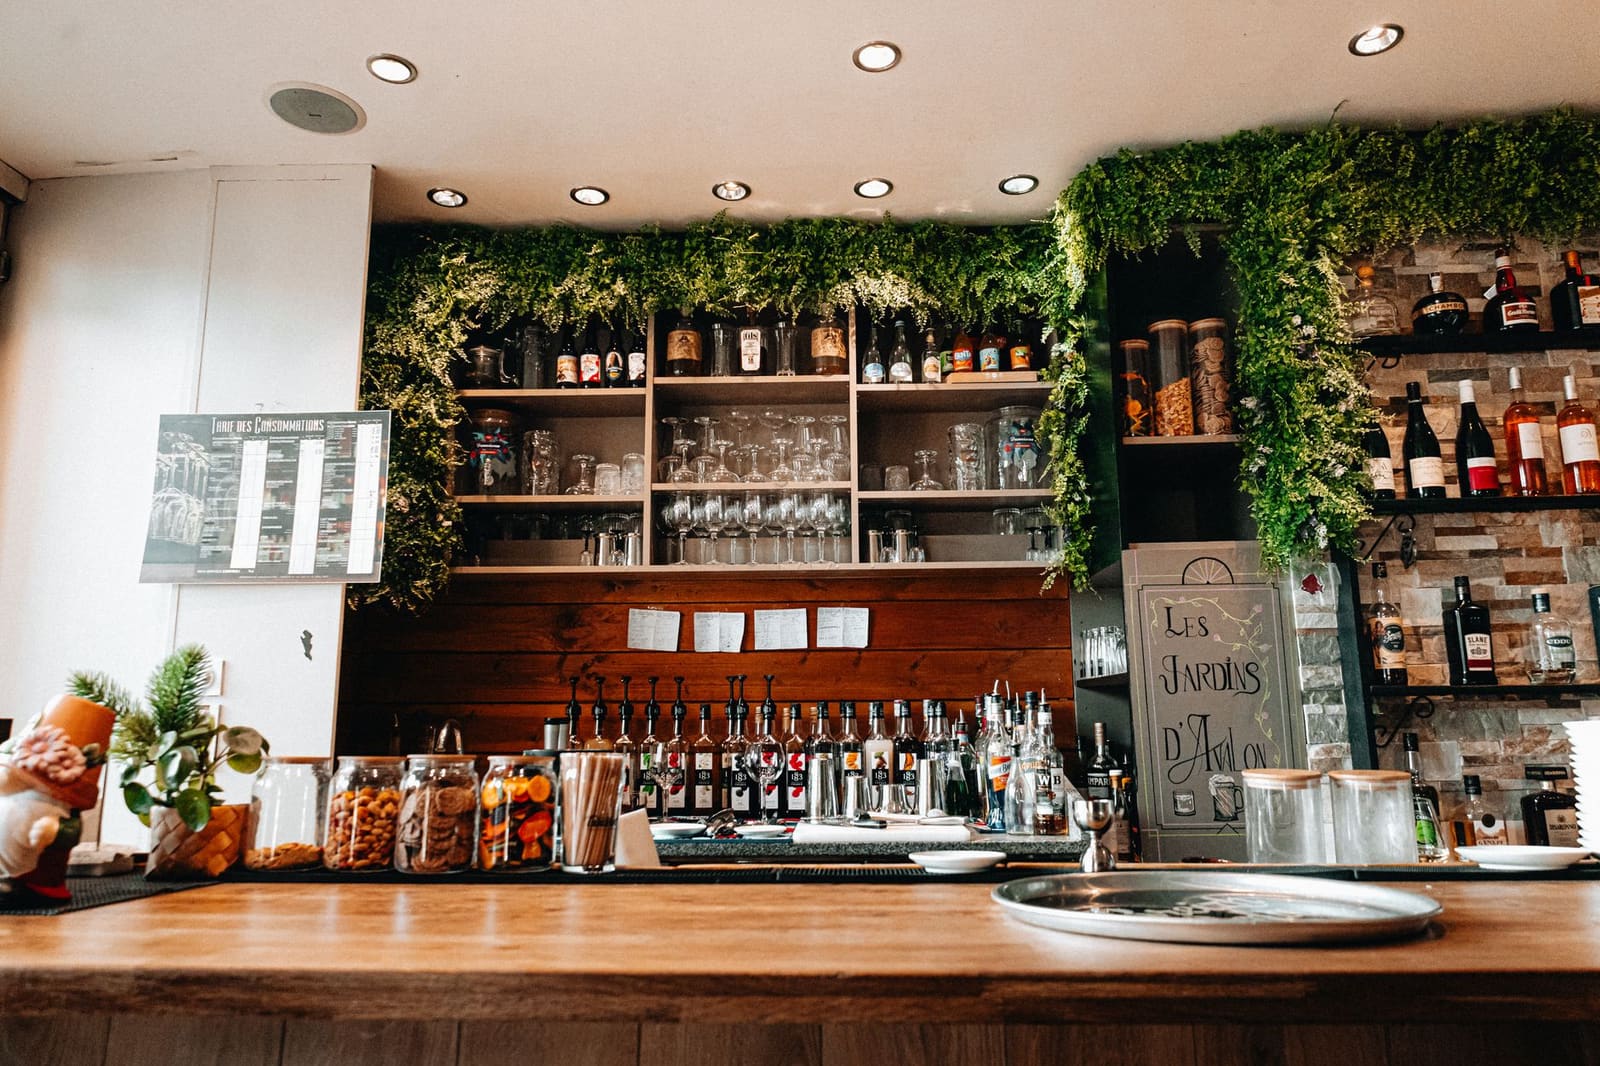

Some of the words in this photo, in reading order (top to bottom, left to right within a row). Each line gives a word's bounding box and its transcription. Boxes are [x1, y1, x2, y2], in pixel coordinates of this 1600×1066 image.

[212, 417, 235, 434] TARIF
[236, 420, 252, 433] DES
[254, 416, 325, 434] CONSOMMATIONS
[1164, 606, 1209, 638] LES
[1467, 636, 1489, 644] SLANE
[1158, 655, 1261, 696] JARDINS
